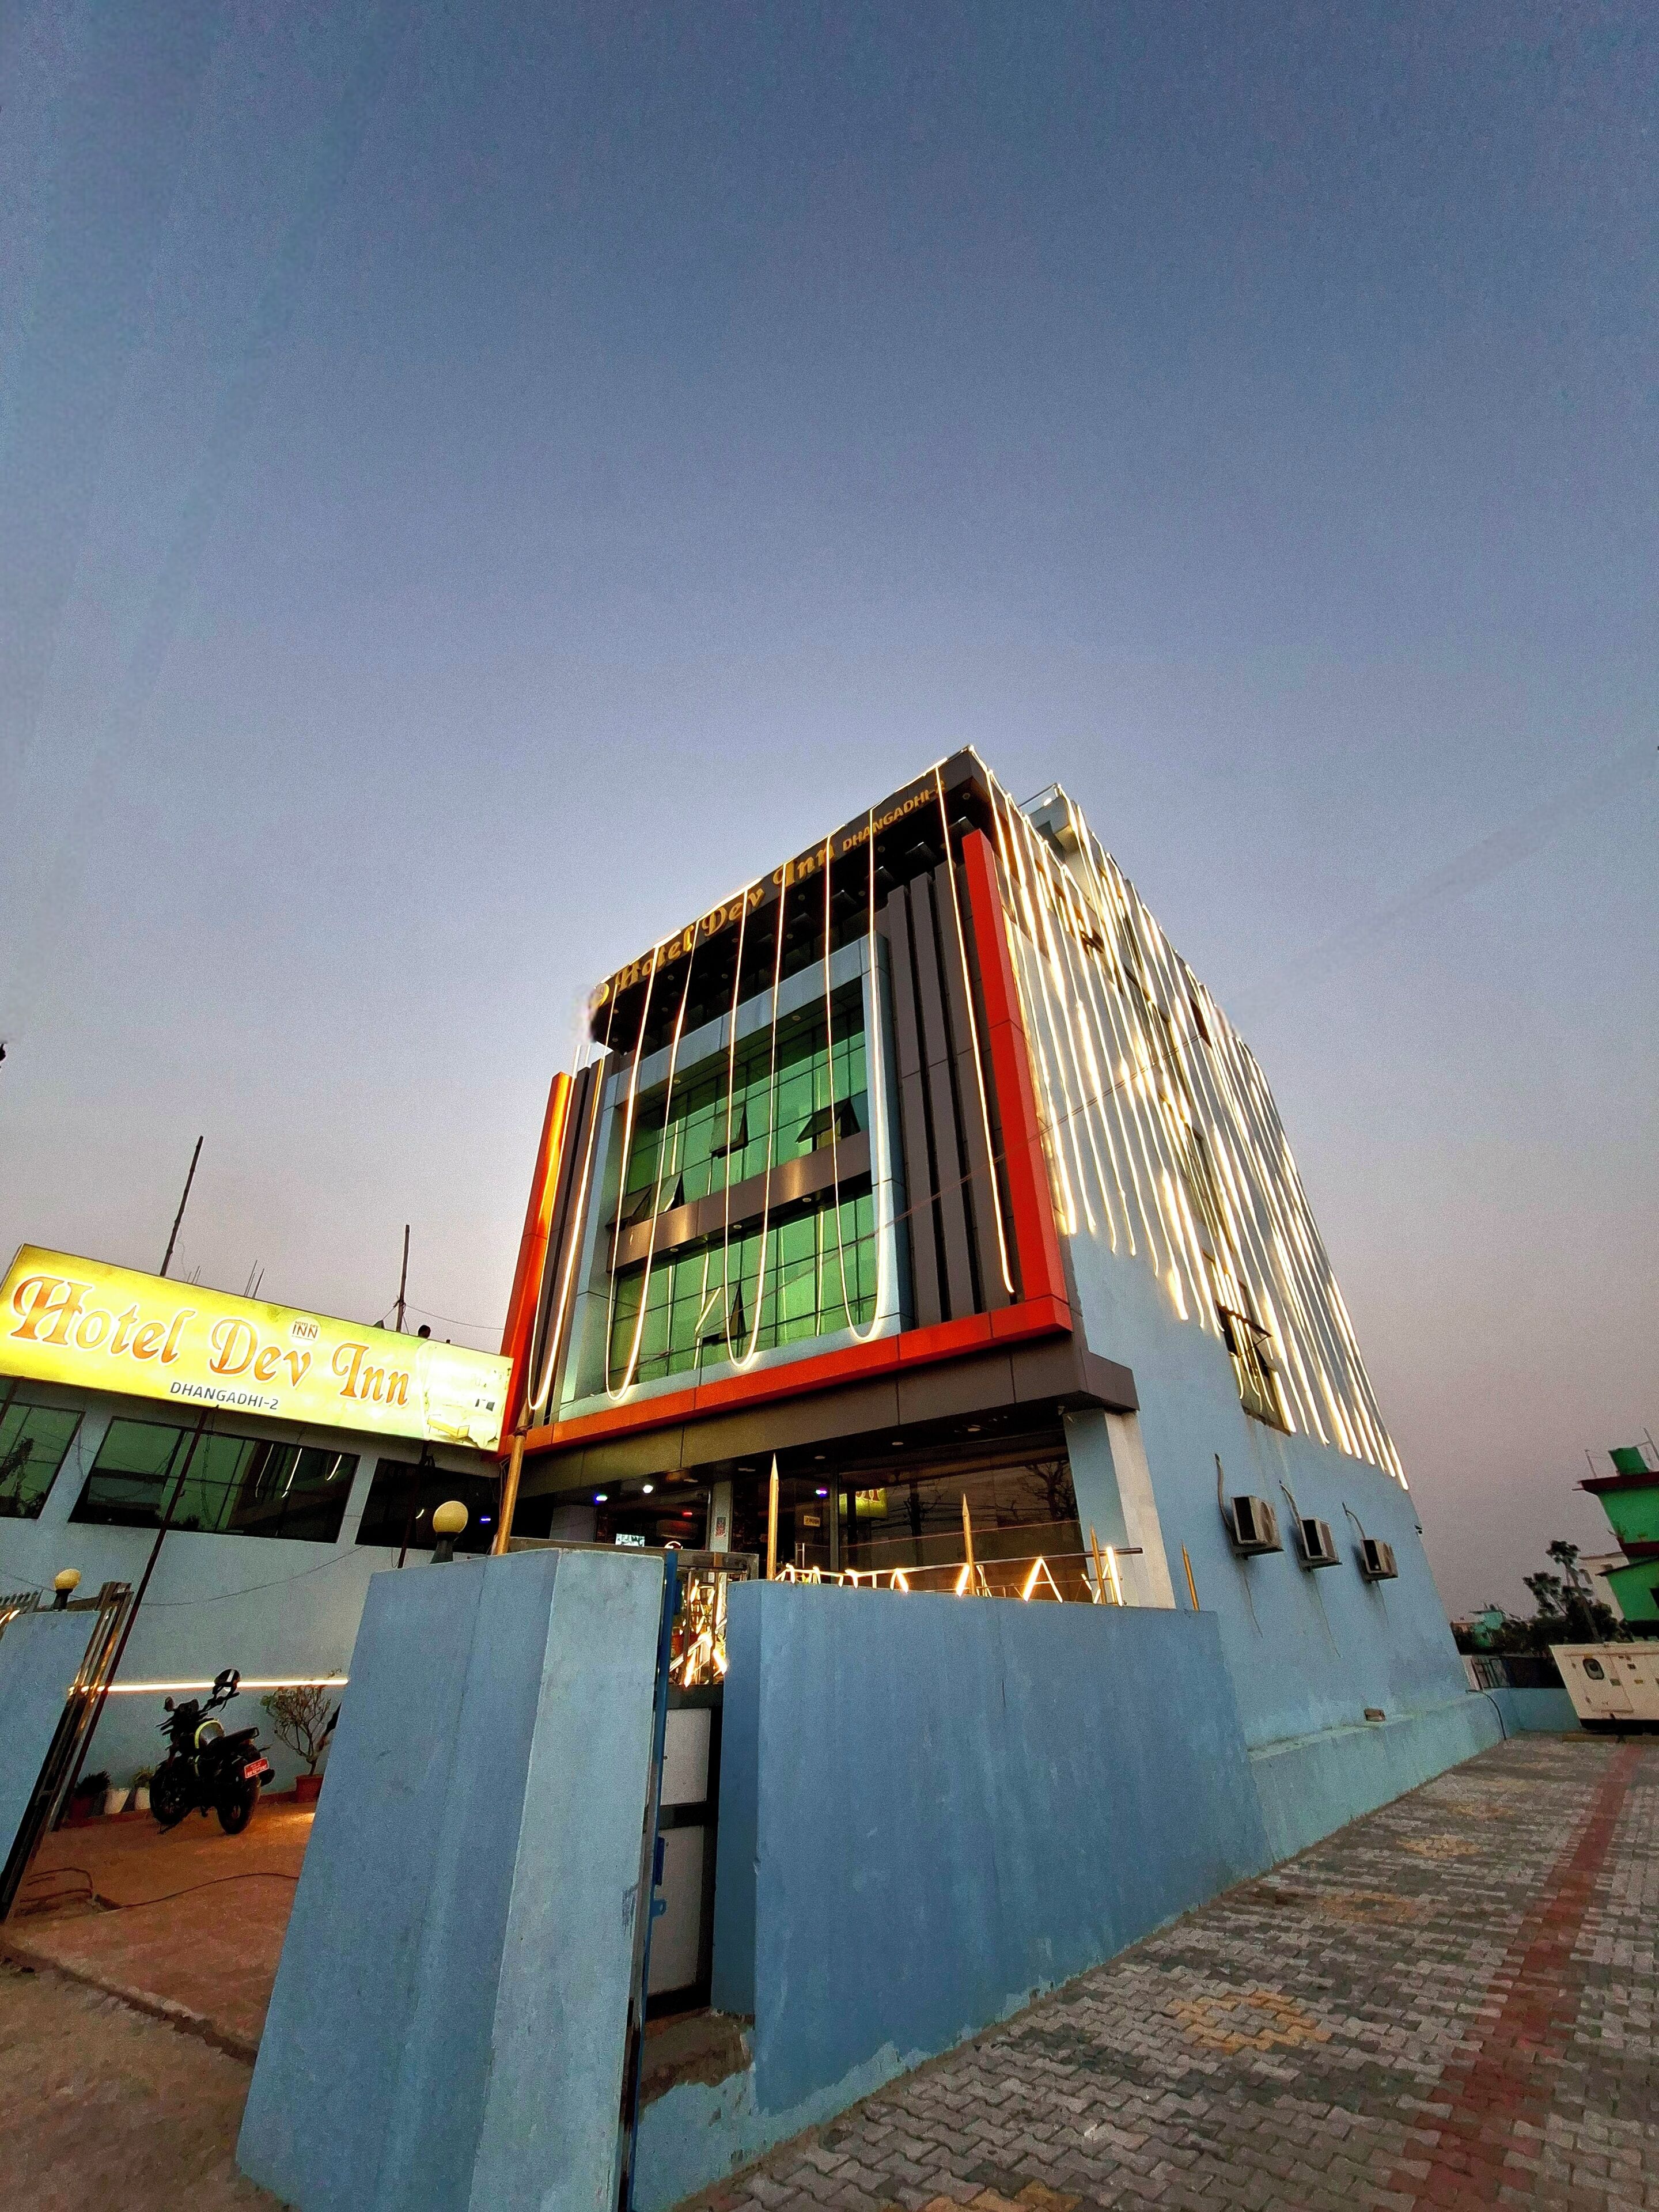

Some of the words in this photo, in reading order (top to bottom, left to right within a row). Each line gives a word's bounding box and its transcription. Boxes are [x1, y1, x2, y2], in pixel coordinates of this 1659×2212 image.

[615, 925, 694, 993] Hotel
[702, 888, 765, 937] Dev
[772, 844, 835, 888] Inn
[11, 1276, 196, 1363] Hotel
[209, 1319, 311, 1387] Dev
[332, 1343, 410, 1406] Inn
[292, 1324, 318, 1339] INN
[171, 1381, 278, 1410] DHANGADHI-2
